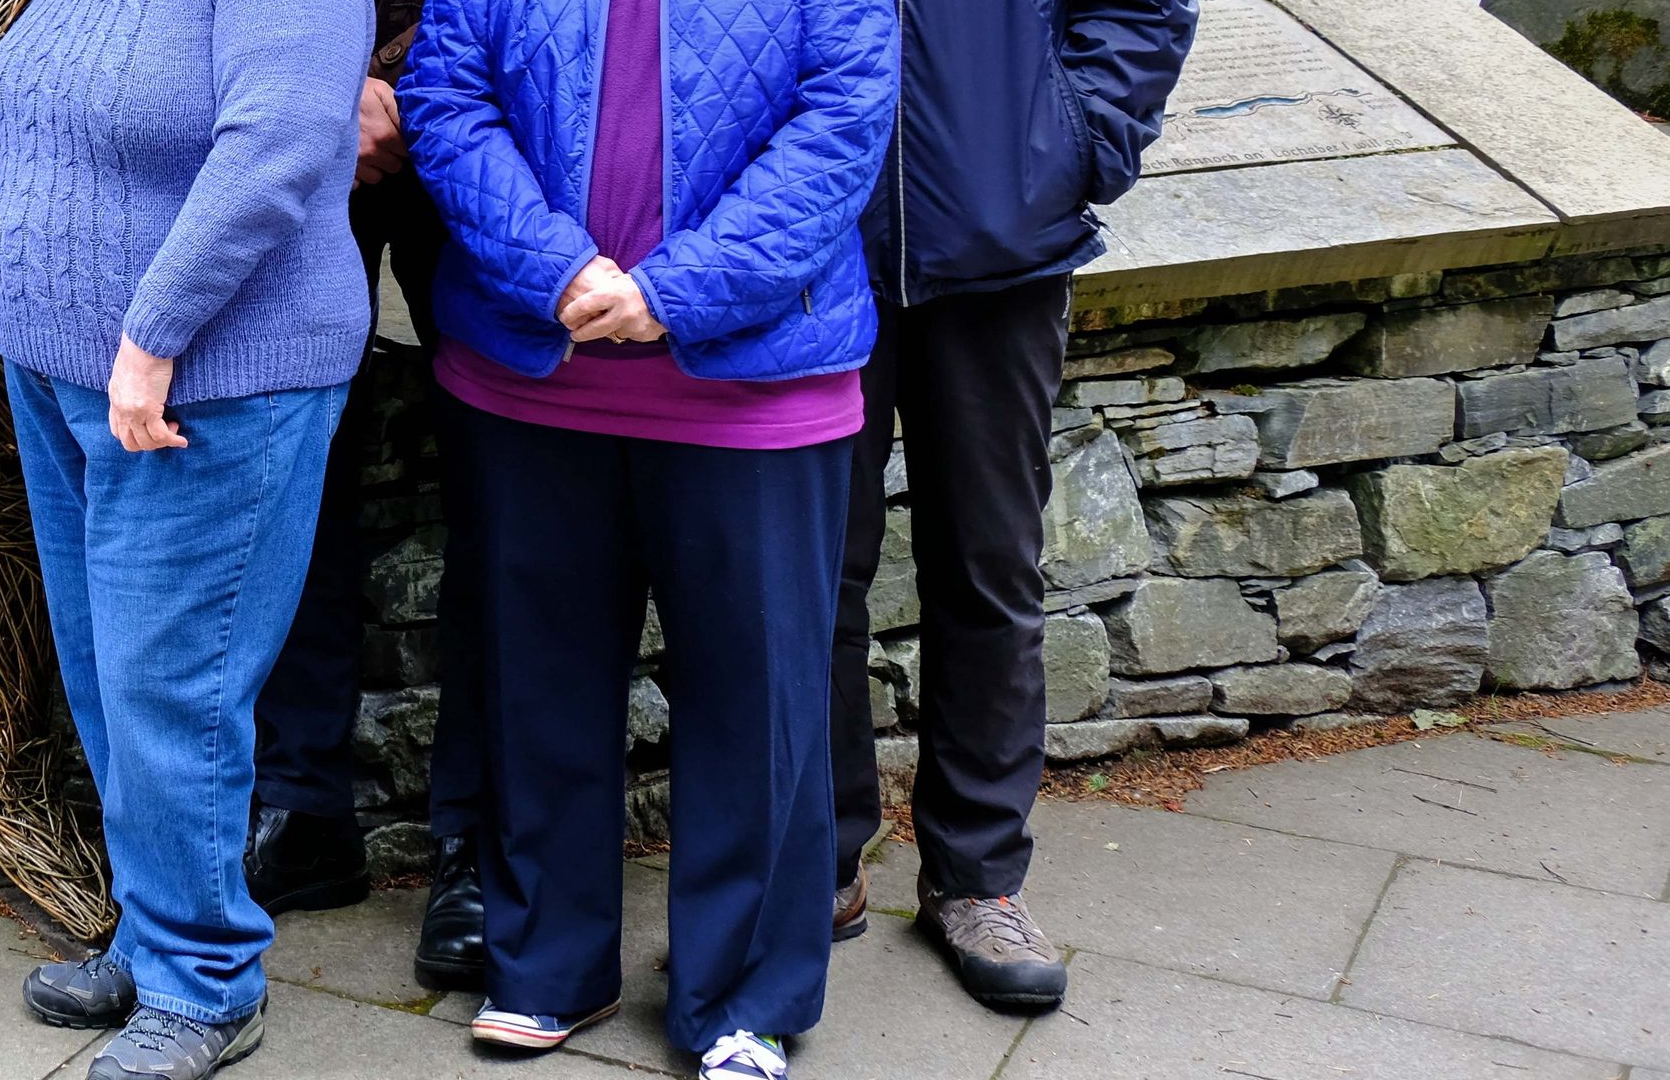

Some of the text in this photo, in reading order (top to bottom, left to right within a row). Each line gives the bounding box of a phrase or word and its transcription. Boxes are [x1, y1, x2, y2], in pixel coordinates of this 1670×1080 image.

[1142, 160, 1170, 170] och
[1171, 153, 1240, 167] Rannoch
[1271, 144, 1339, 158] Lochaber
[1353, 139, 1382, 150] will
